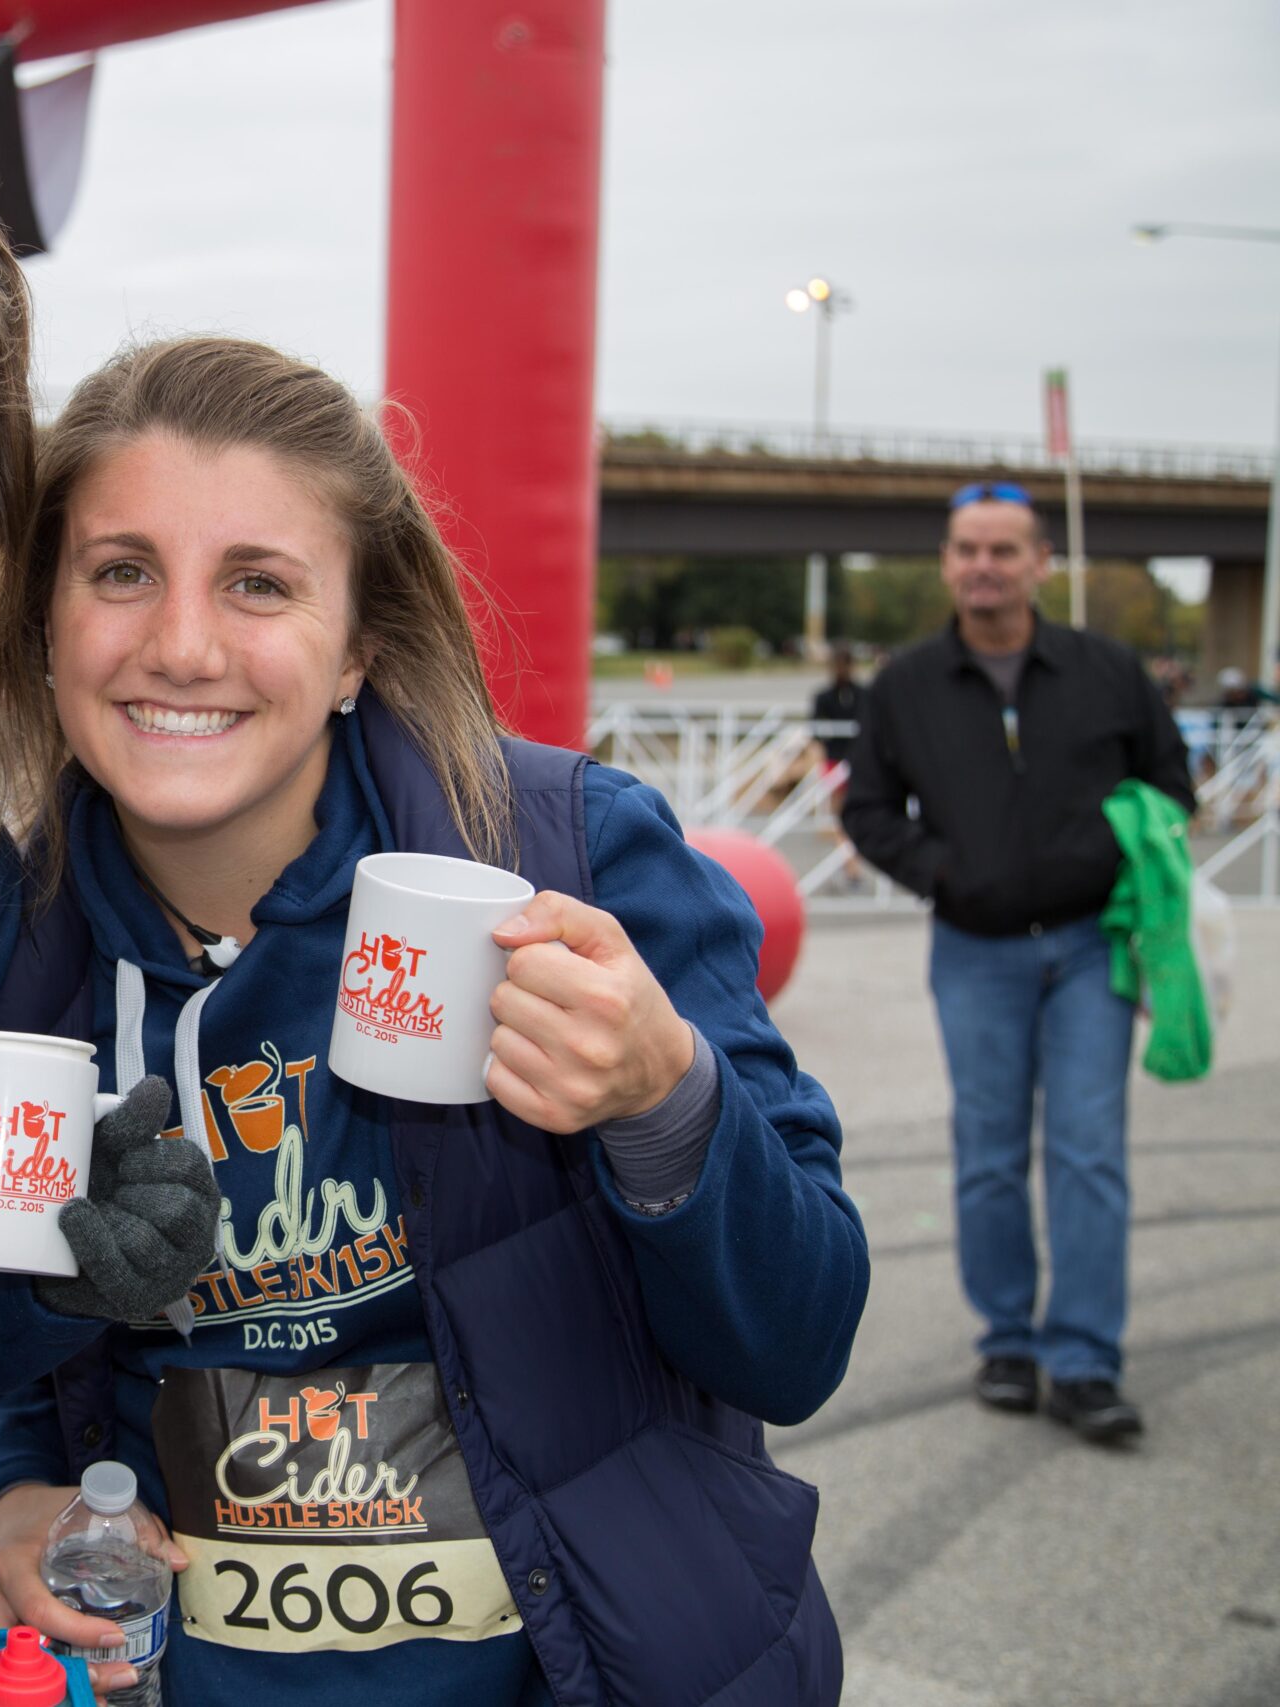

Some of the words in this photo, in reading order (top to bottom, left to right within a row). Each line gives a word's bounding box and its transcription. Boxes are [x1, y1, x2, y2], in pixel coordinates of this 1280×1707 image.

[342, 951, 444, 1018] Cider
[338, 985, 379, 1021] HUSTLE
[381, 1009, 444, 1034] 5K/15K
[356, 1021, 373, 1036] D.C.
[374, 1029, 399, 1044] 2015
[27, 1177, 77, 1199] 5K/15K
[20, 1201, 45, 1213] 2015
[243, 1322, 285, 1351] D.C.
[215, 1426, 419, 1507] Cider
[214, 1499, 321, 1528] HUSTLE
[327, 1496, 425, 1528] 5K/15K
[214, 1560, 454, 1635] 2606
